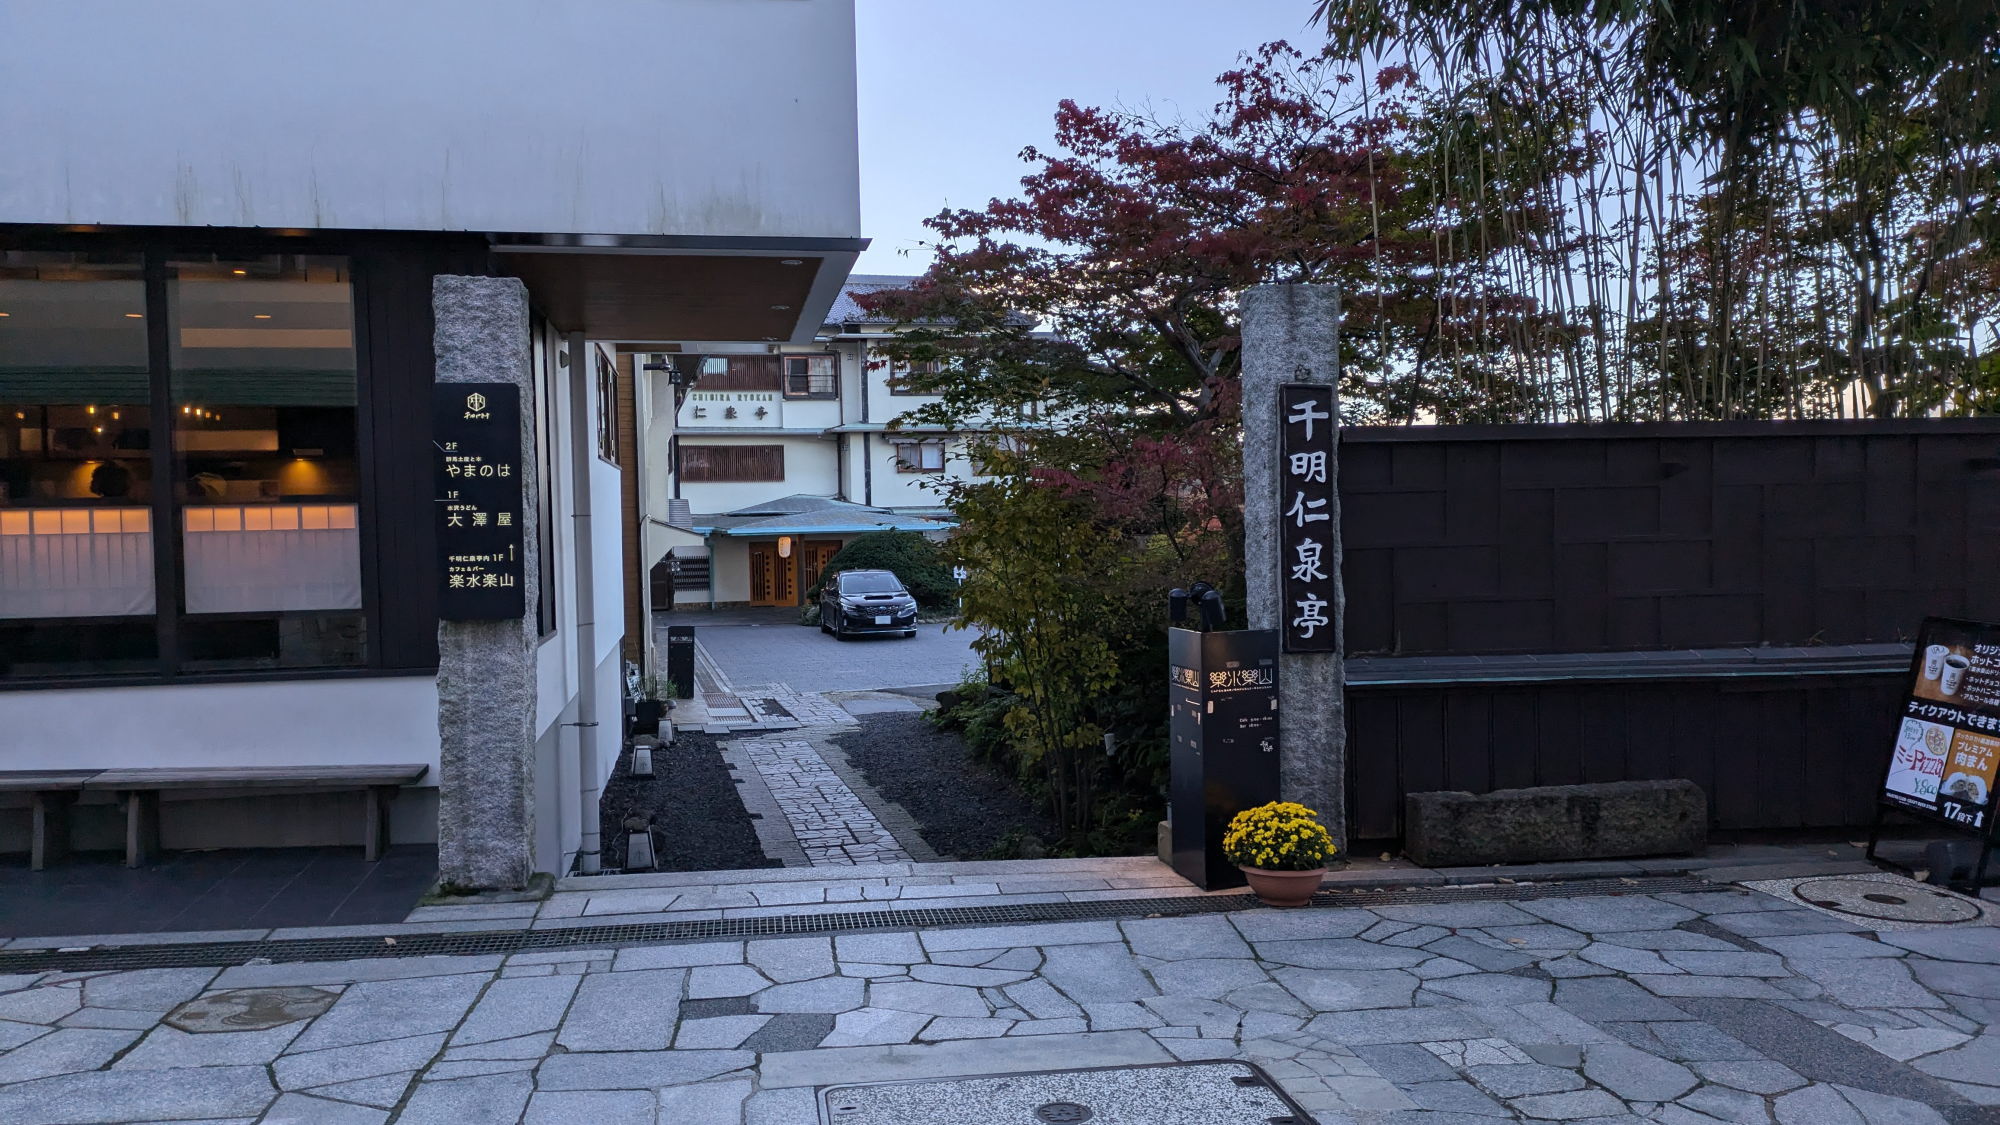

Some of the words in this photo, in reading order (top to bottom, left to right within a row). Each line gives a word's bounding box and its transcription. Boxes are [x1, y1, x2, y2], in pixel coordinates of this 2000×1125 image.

[737, 393, 773, 402] RYOKAN
[445, 442, 458, 450] 2F
[445, 464, 511, 478] やまのは
[447, 491, 459, 499] 1F
[447, 512, 512, 527] 大澤屋
[1286, 399, 1330, 640] 千明仁泉亭
[493, 554, 504, 562] 1F
[449, 572, 514, 588] 楽水楽山
[1958, 741, 1993, 757] プレミアム
[1954, 751, 1988, 771] 肉まん
